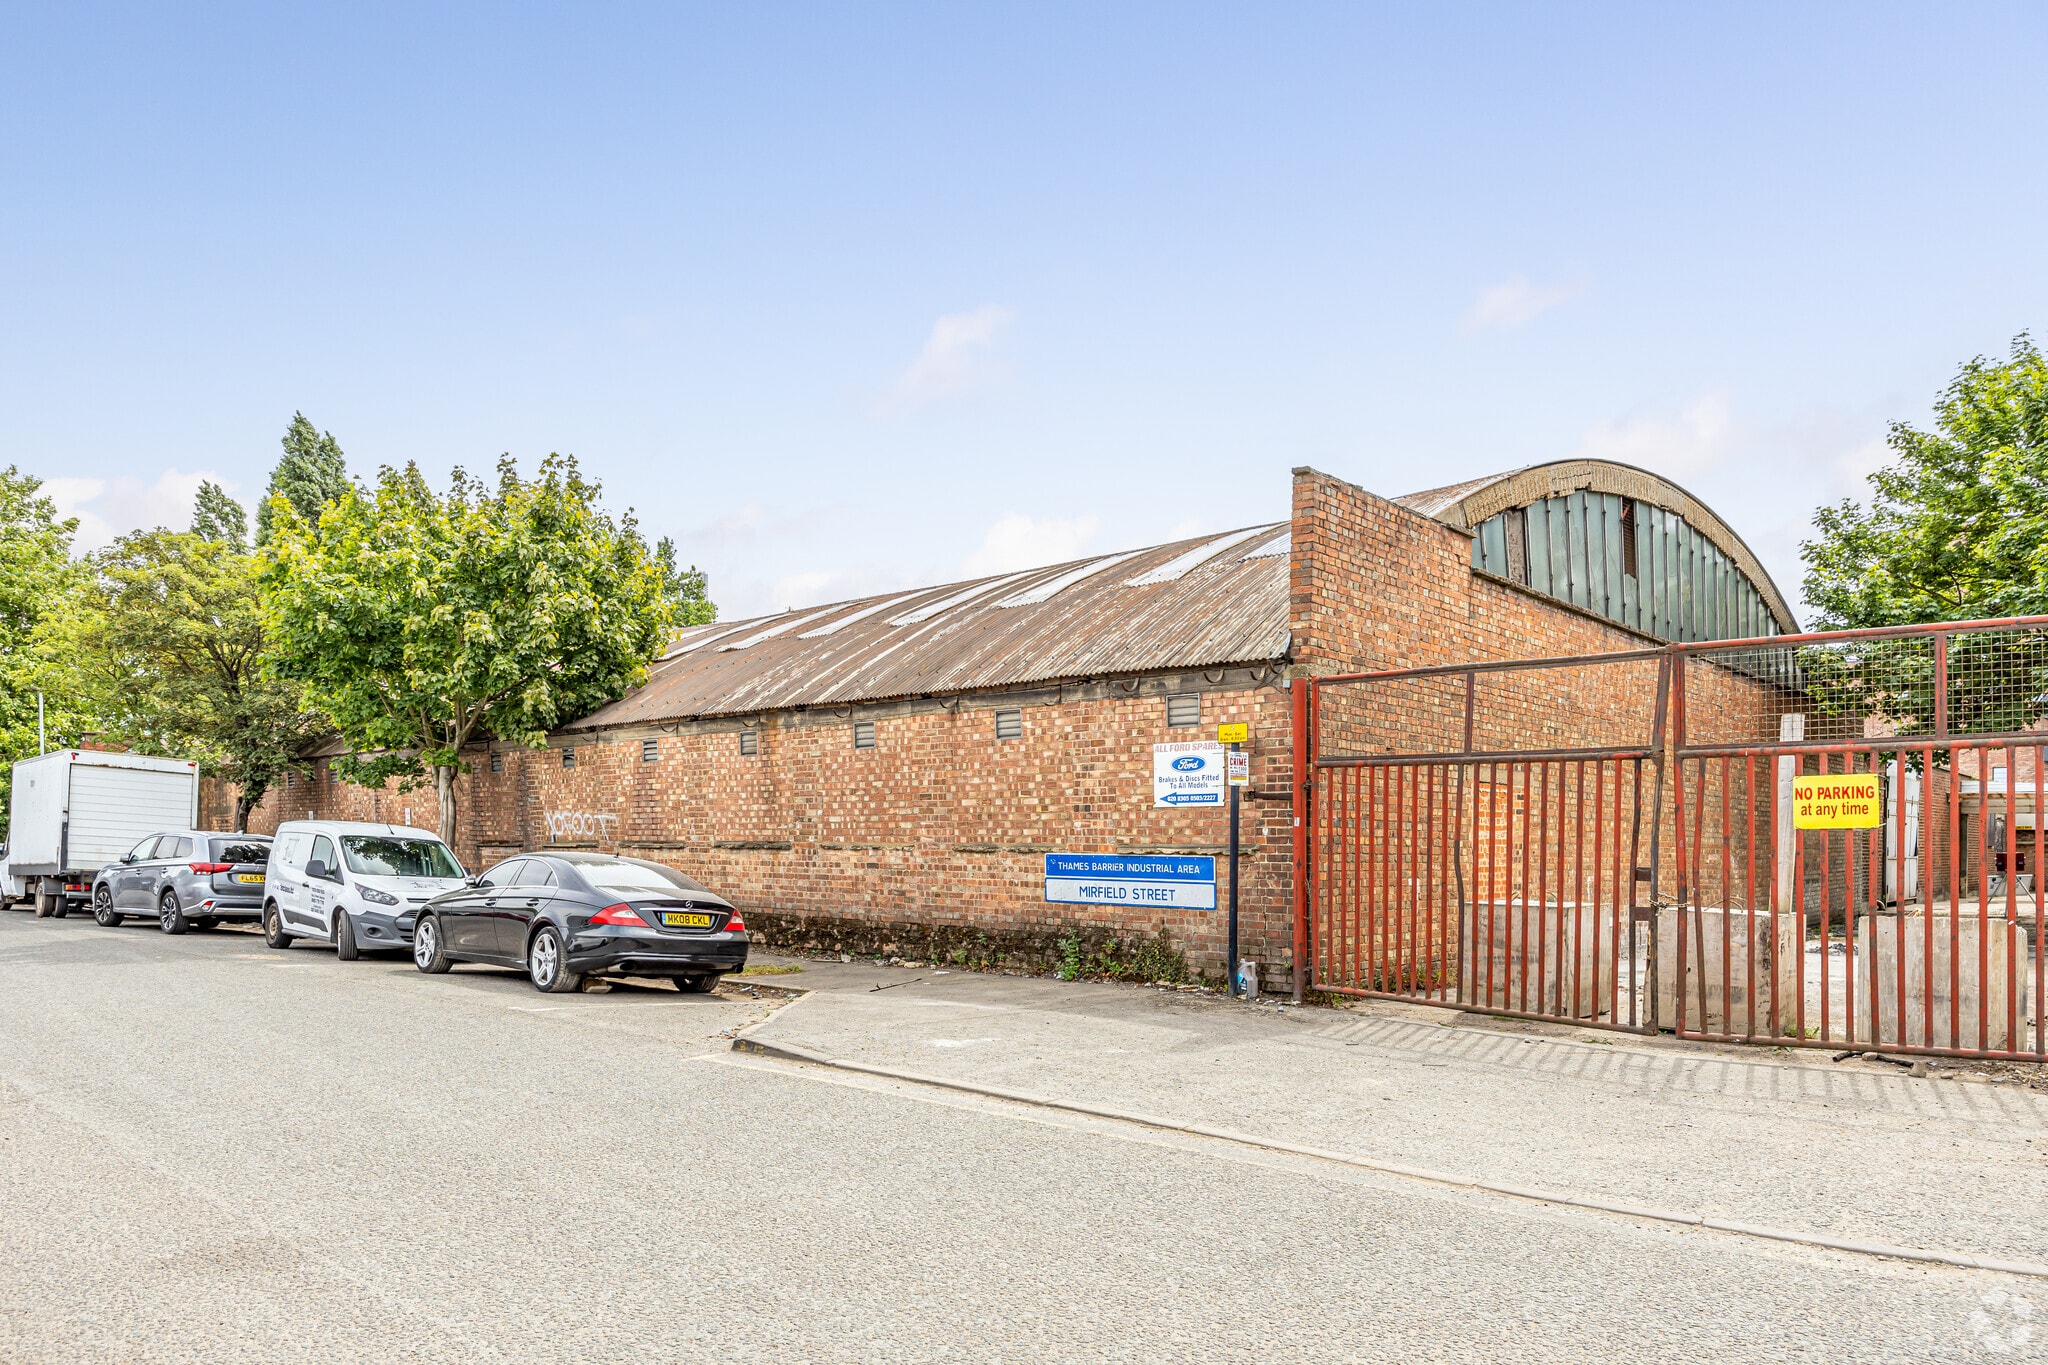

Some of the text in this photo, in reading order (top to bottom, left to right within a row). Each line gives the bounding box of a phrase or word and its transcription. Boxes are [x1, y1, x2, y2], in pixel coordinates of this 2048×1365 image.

[1154, 742, 1223, 753] ALL FORD SPARES
[1178, 758, 1199, 769] Ford
[1230, 758, 1247, 767] CRIME
[1795, 785, 1875, 800] NO PARKING
[1801, 801, 1869, 819] at any time
[1057, 861, 1201, 874] THAMES BARRIER INDUSTRIAL AREA
[1079, 886, 1176, 901] MIRFIELD STREET
[692, 915, 709, 926] CKL
